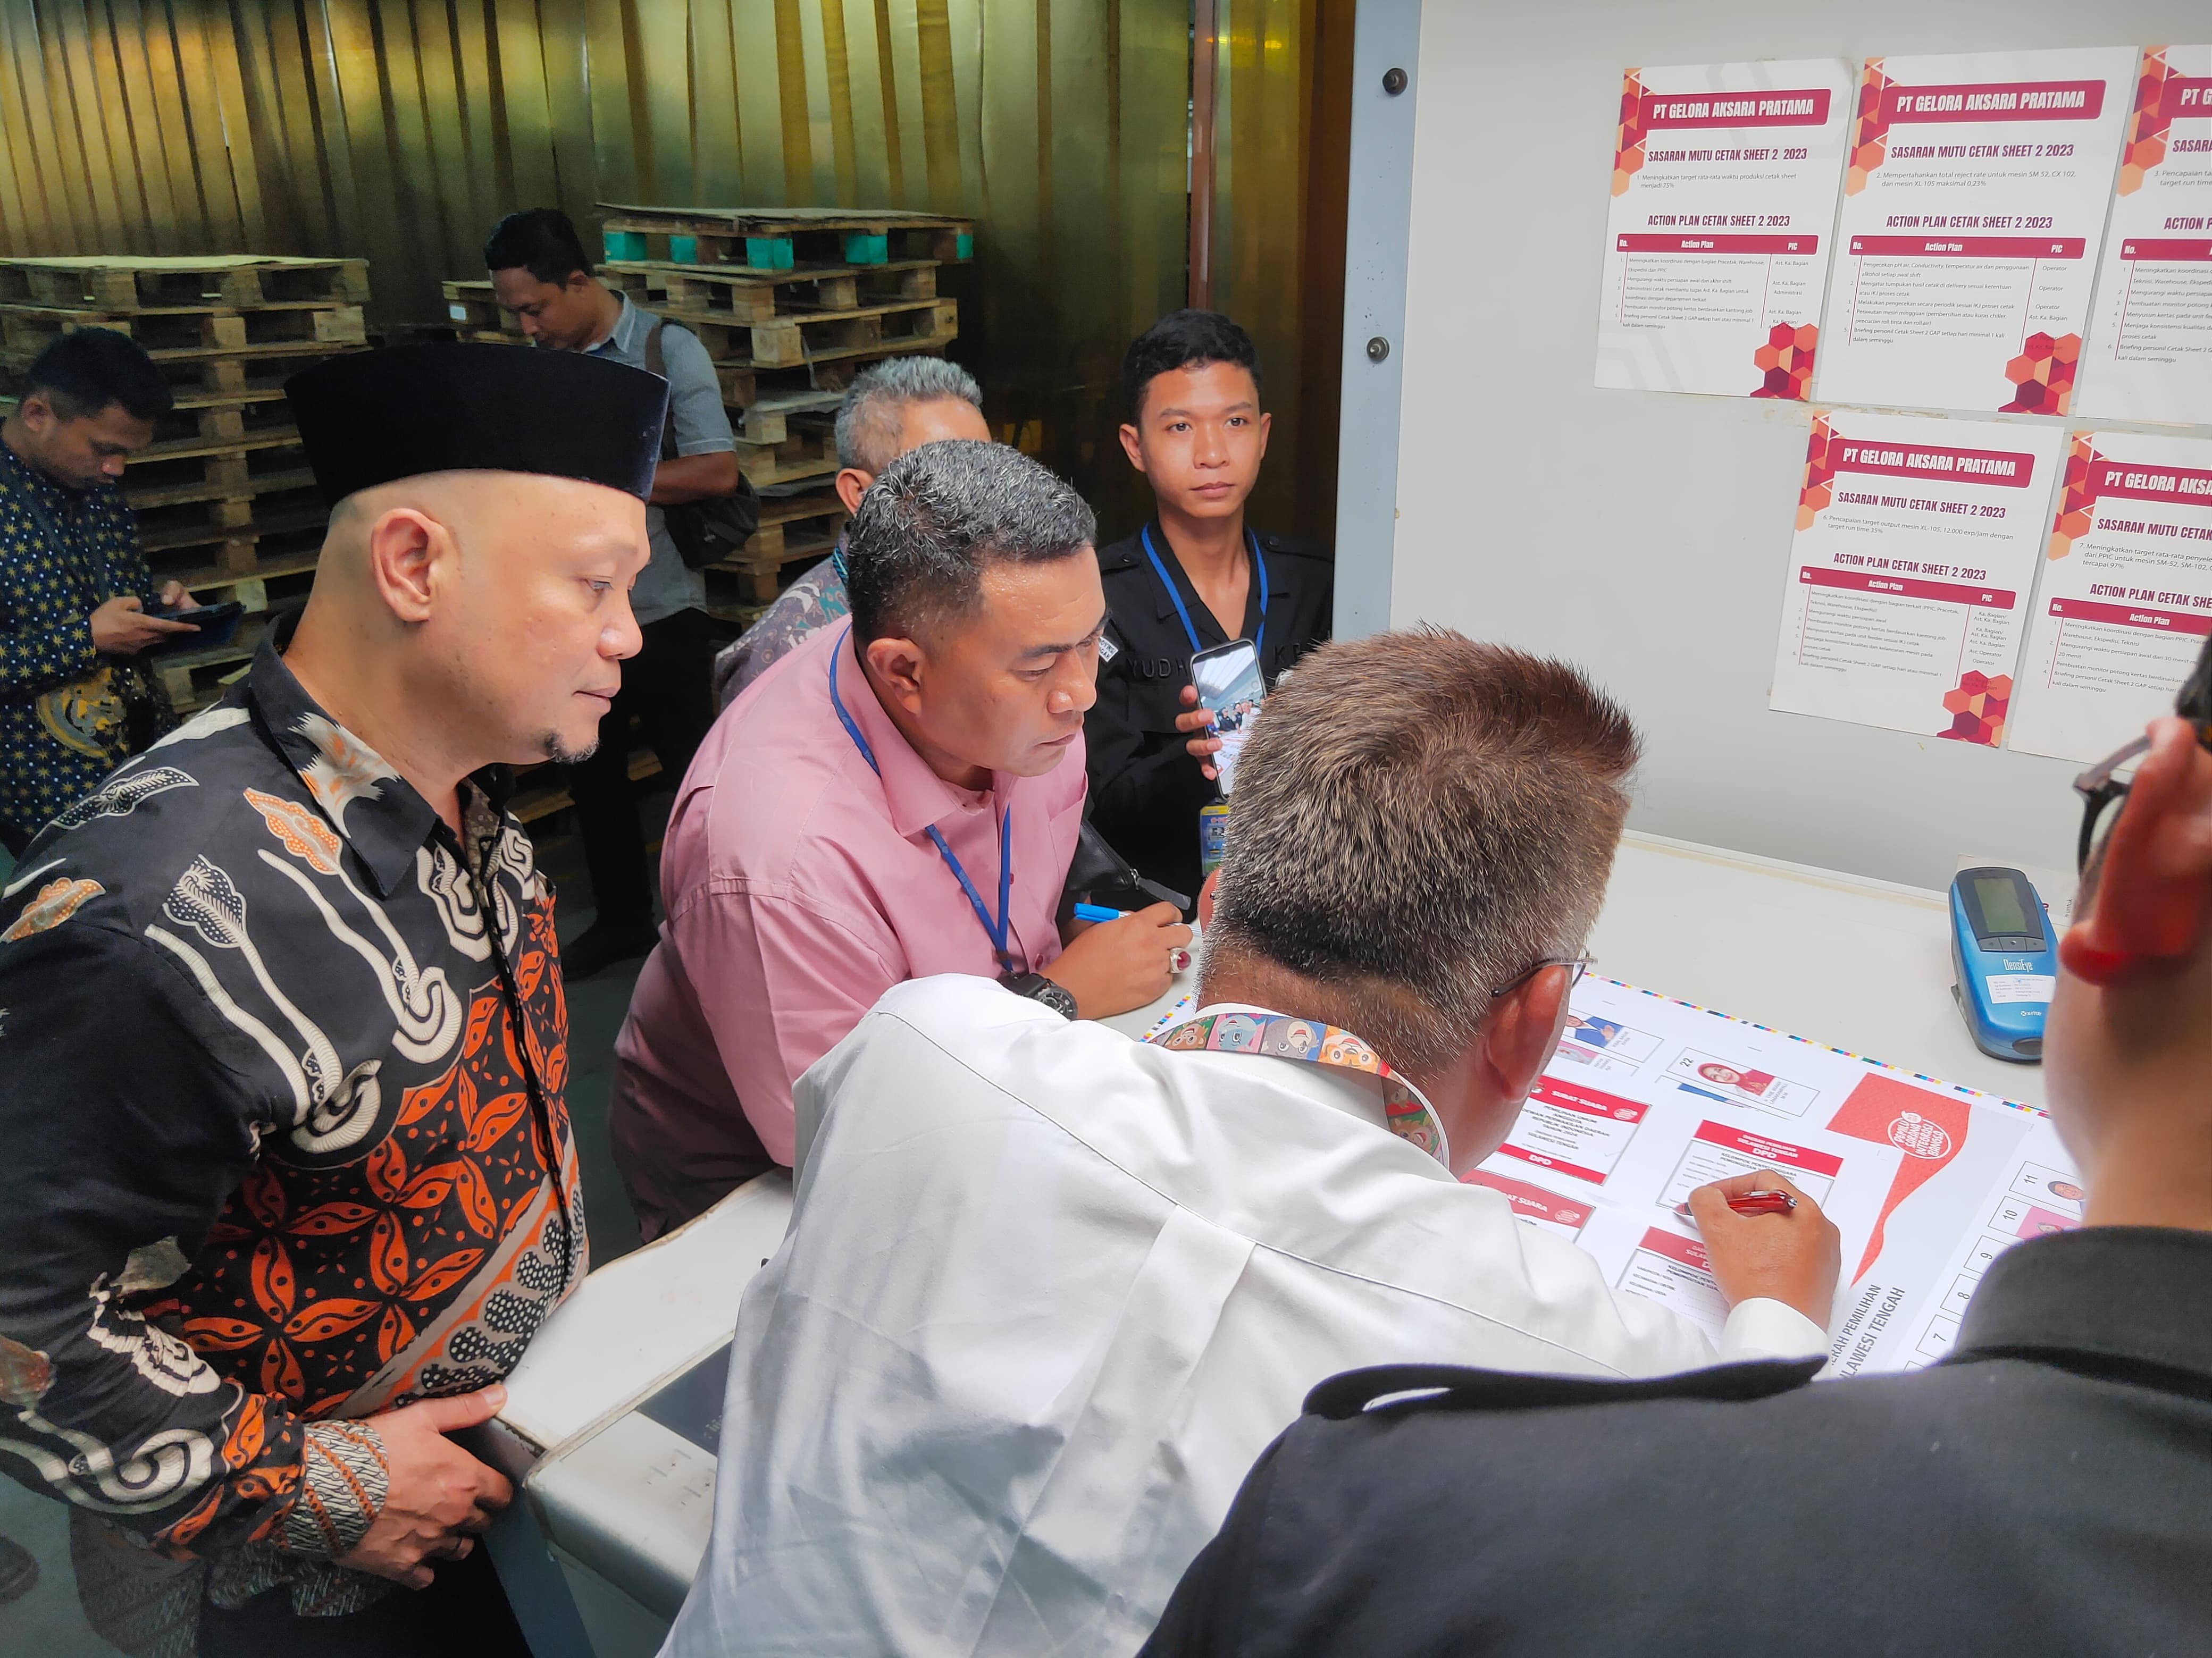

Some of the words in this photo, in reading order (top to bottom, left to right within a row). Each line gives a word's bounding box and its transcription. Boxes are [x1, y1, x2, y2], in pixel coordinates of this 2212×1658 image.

[1896, 96, 1914, 112] PT
[1915, 95, 1963, 112] GELORA
[1965, 93, 2017, 111] AKSARA
[2020, 91, 2085, 109] PRATAMA
[2181, 88, 2200, 105] PT
[1653, 104, 1667, 119] PT
[1669, 103, 1709, 119] GELORA
[1712, 101, 1755, 118] AKSARA
[1758, 99, 1814, 116] PRATAMA
[1648, 150, 1686, 162] SASARAN
[1688, 150, 1713, 161] MUTU
[1715, 149, 1741, 161] CETAK
[1743, 149, 1770, 160] SHEET
[1771, 149, 1778, 160] 2
[1783, 148, 1807, 159] 2023
[1891, 146, 1935, 158] SASARAN
[1938, 145, 1966, 158] MUTU
[1968, 145, 1999, 157] CETAK
[2002, 145, 2032, 157] SHEET
[2035, 144, 2042, 156] 2
[2046, 144, 2074, 156] 2023
[1648, 215, 1676, 226] ACTION
[1679, 216, 1700, 226] PLAN
[1702, 216, 1728, 226] CETAK
[1730, 216, 1756, 226] SHEET
[1758, 216, 1764, 226] 2
[1766, 216, 1790, 227] 2023
[1886, 216, 1920, 227] ACTION
[1922, 216, 1947, 228] PLAN
[1950, 216, 1979, 228] CETAK
[1982, 216, 2012, 228] SHEET
[2015, 216, 2022, 228] 2
[2025, 216, 2053, 229] 2023
[2164, 217, 2203, 230] ACTION
[1787, 242, 1798, 251] PIC
[1924, 242, 1946, 251] Action
[2051, 245, 2063, 253] PIC
[1842, 448, 1858, 462] PT
[1861, 450, 1903, 467] GELORA
[1906, 453, 1953, 471] AKSARA
[1956, 457, 2016, 477] PRATAMA
[2105, 471, 2124, 486] PT
[2125, 473, 2175, 492] GELORA
[2178, 477, 2212, 495] AKSA
[1838, 492, 1879, 506] SASARAN
[1881, 496, 1907, 508] MUTU
[1909, 499, 1937, 511] CETAK
[1939, 502, 1968, 515] SHEET
[1971, 505, 1978, 515] 2
[1980, 506, 2006, 518] 2023
[1829, 515, 1861, 524] Pencapaian
[2097, 518, 2144, 534] SASARAN
[2147, 523, 2177, 536] MUTU
[2086, 544, 2133, 554] Meningkatkan
[1833, 553, 1864, 566] ACTION
[1866, 557, 1889, 569] PLAN
[1891, 560, 1919, 573] CETAK
[1921, 563, 1949, 576] SHEET
[1952, 567, 1958, 577] 2
[1961, 568, 1987, 580] 2023
[2156, 559, 2179, 568] SM-52,
[2180, 562, 2208, 571] SM-102,
[1868, 580, 1888, 590] Action
[1889, 582, 1903, 591] Plan
[1981, 593, 1993, 602] PIC
[2090, 584, 2126, 599] ACTION
[2128, 588, 2155, 601] PLAN
[2157, 592, 2190, 605] CETAK
[2192, 596, 2212, 608] SHE
[2051, 603, 2063, 613] No.
[2129, 613, 2153, 623] Action
[2154, 617, 2170, 626] Plan
[2003, 958, 2033, 973] DensiEye
[1680, 1057, 1694, 1067] 22
[1893, 1120, 1909, 1143] PEMILU
[1914, 1123, 1934, 1156] INTEGRASI
[1926, 1130, 1945, 1157] BANGSA
[1528, 1154, 1552, 1166] DPD
[1752, 1148, 1778, 1159] DPD
[2024, 1174, 2039, 1185] 11
[2003, 1209, 2018, 1222] 10
[1980, 1252, 1993, 1261] 9
[1958, 1291, 1971, 1300] 8
[1841, 1284, 1881, 1336] PEMILIHAN
[1867, 1286, 1906, 1332] TENGAH
[1932, 1334, 1947, 1343] 7
